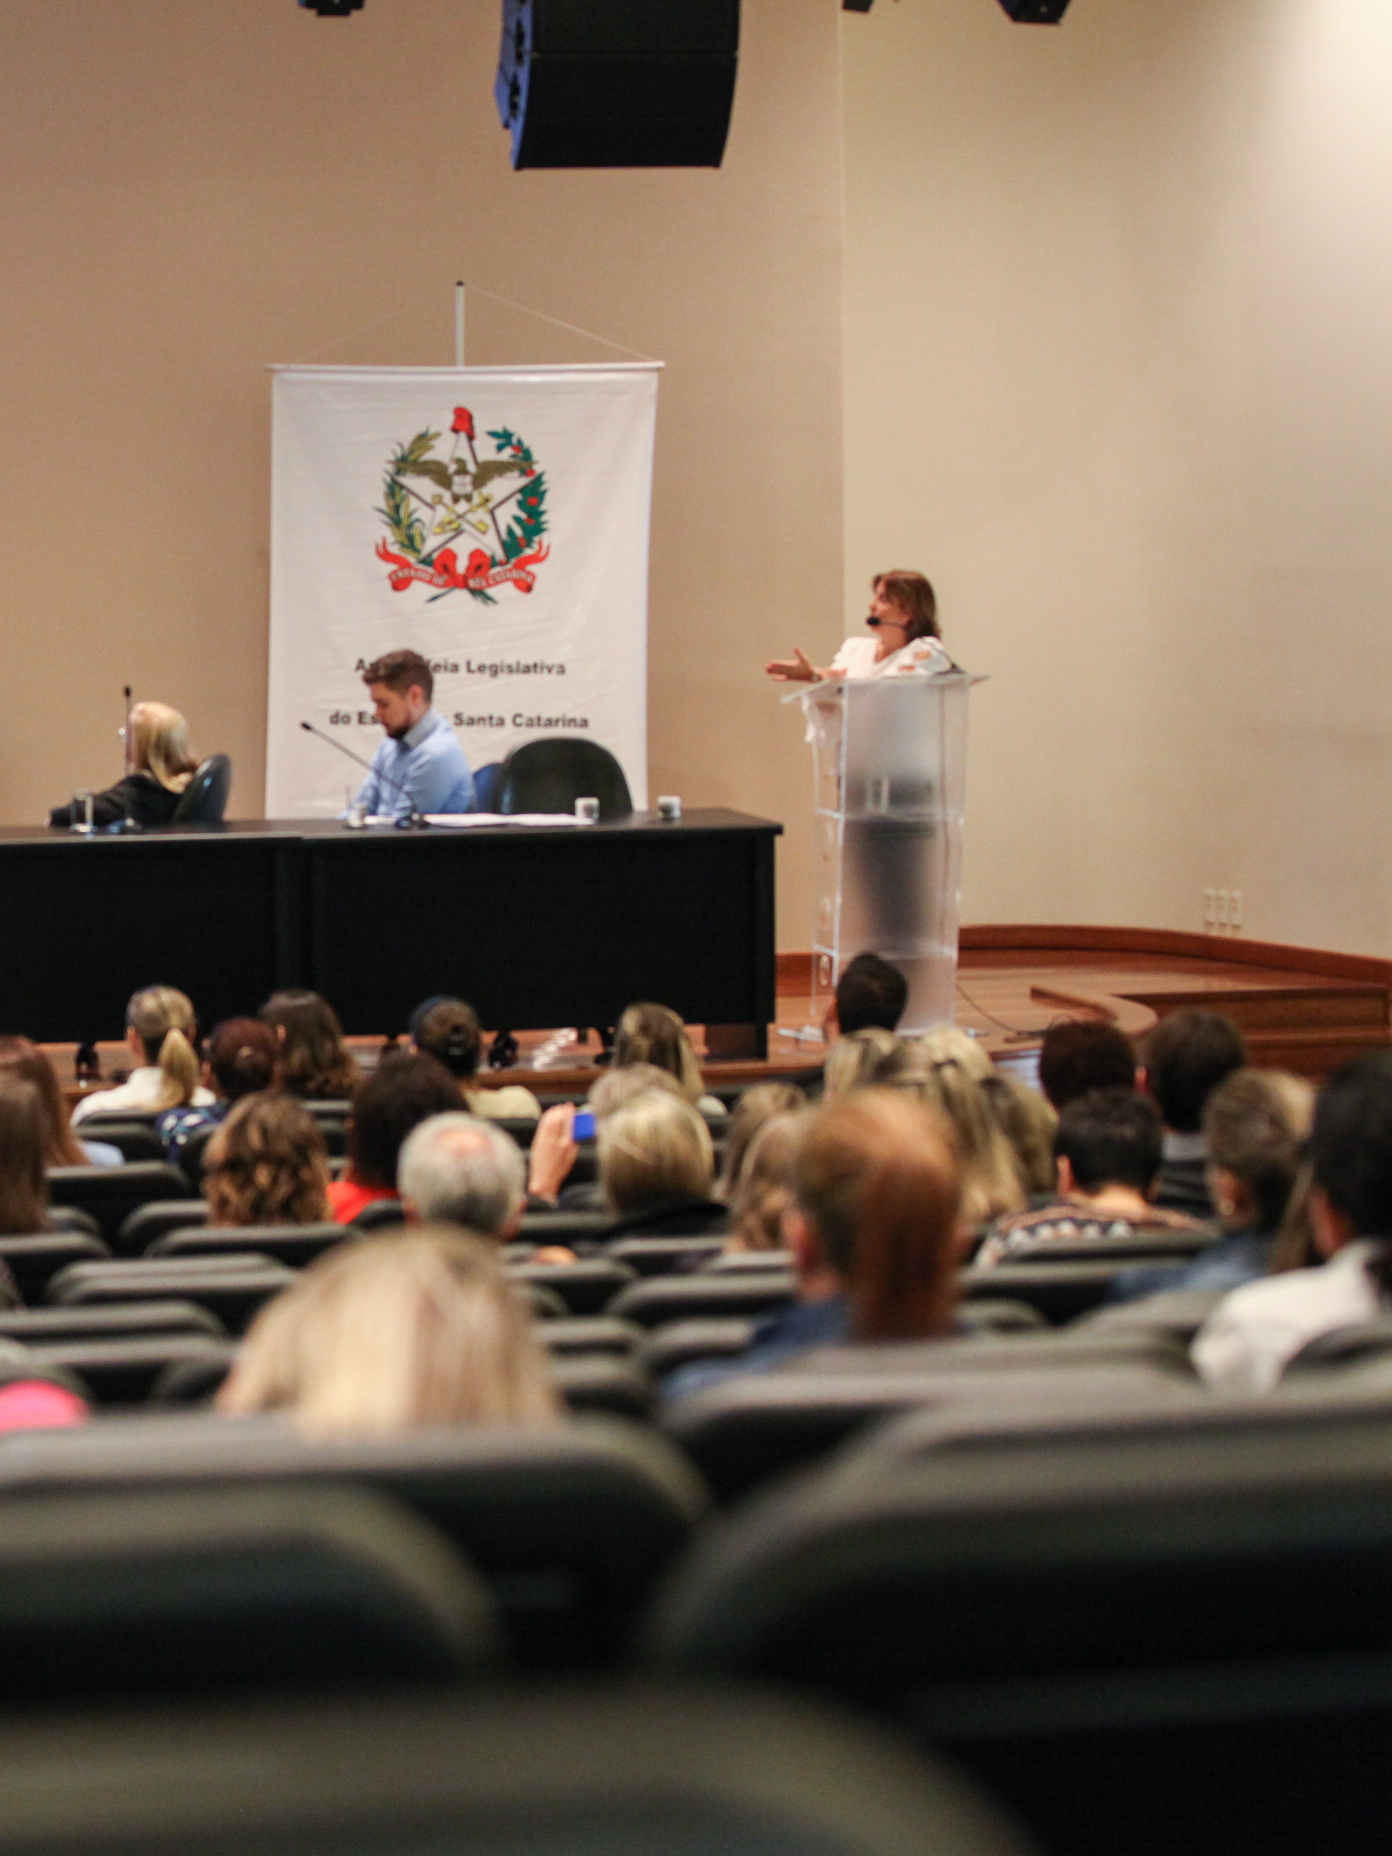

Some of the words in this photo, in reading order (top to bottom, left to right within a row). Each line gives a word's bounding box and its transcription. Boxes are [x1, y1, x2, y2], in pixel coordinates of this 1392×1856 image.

[466, 660, 565, 677] Legislativa
[330, 710, 351, 724] do
[454, 714, 504, 727] Santa
[512, 714, 589, 728] Catarina
